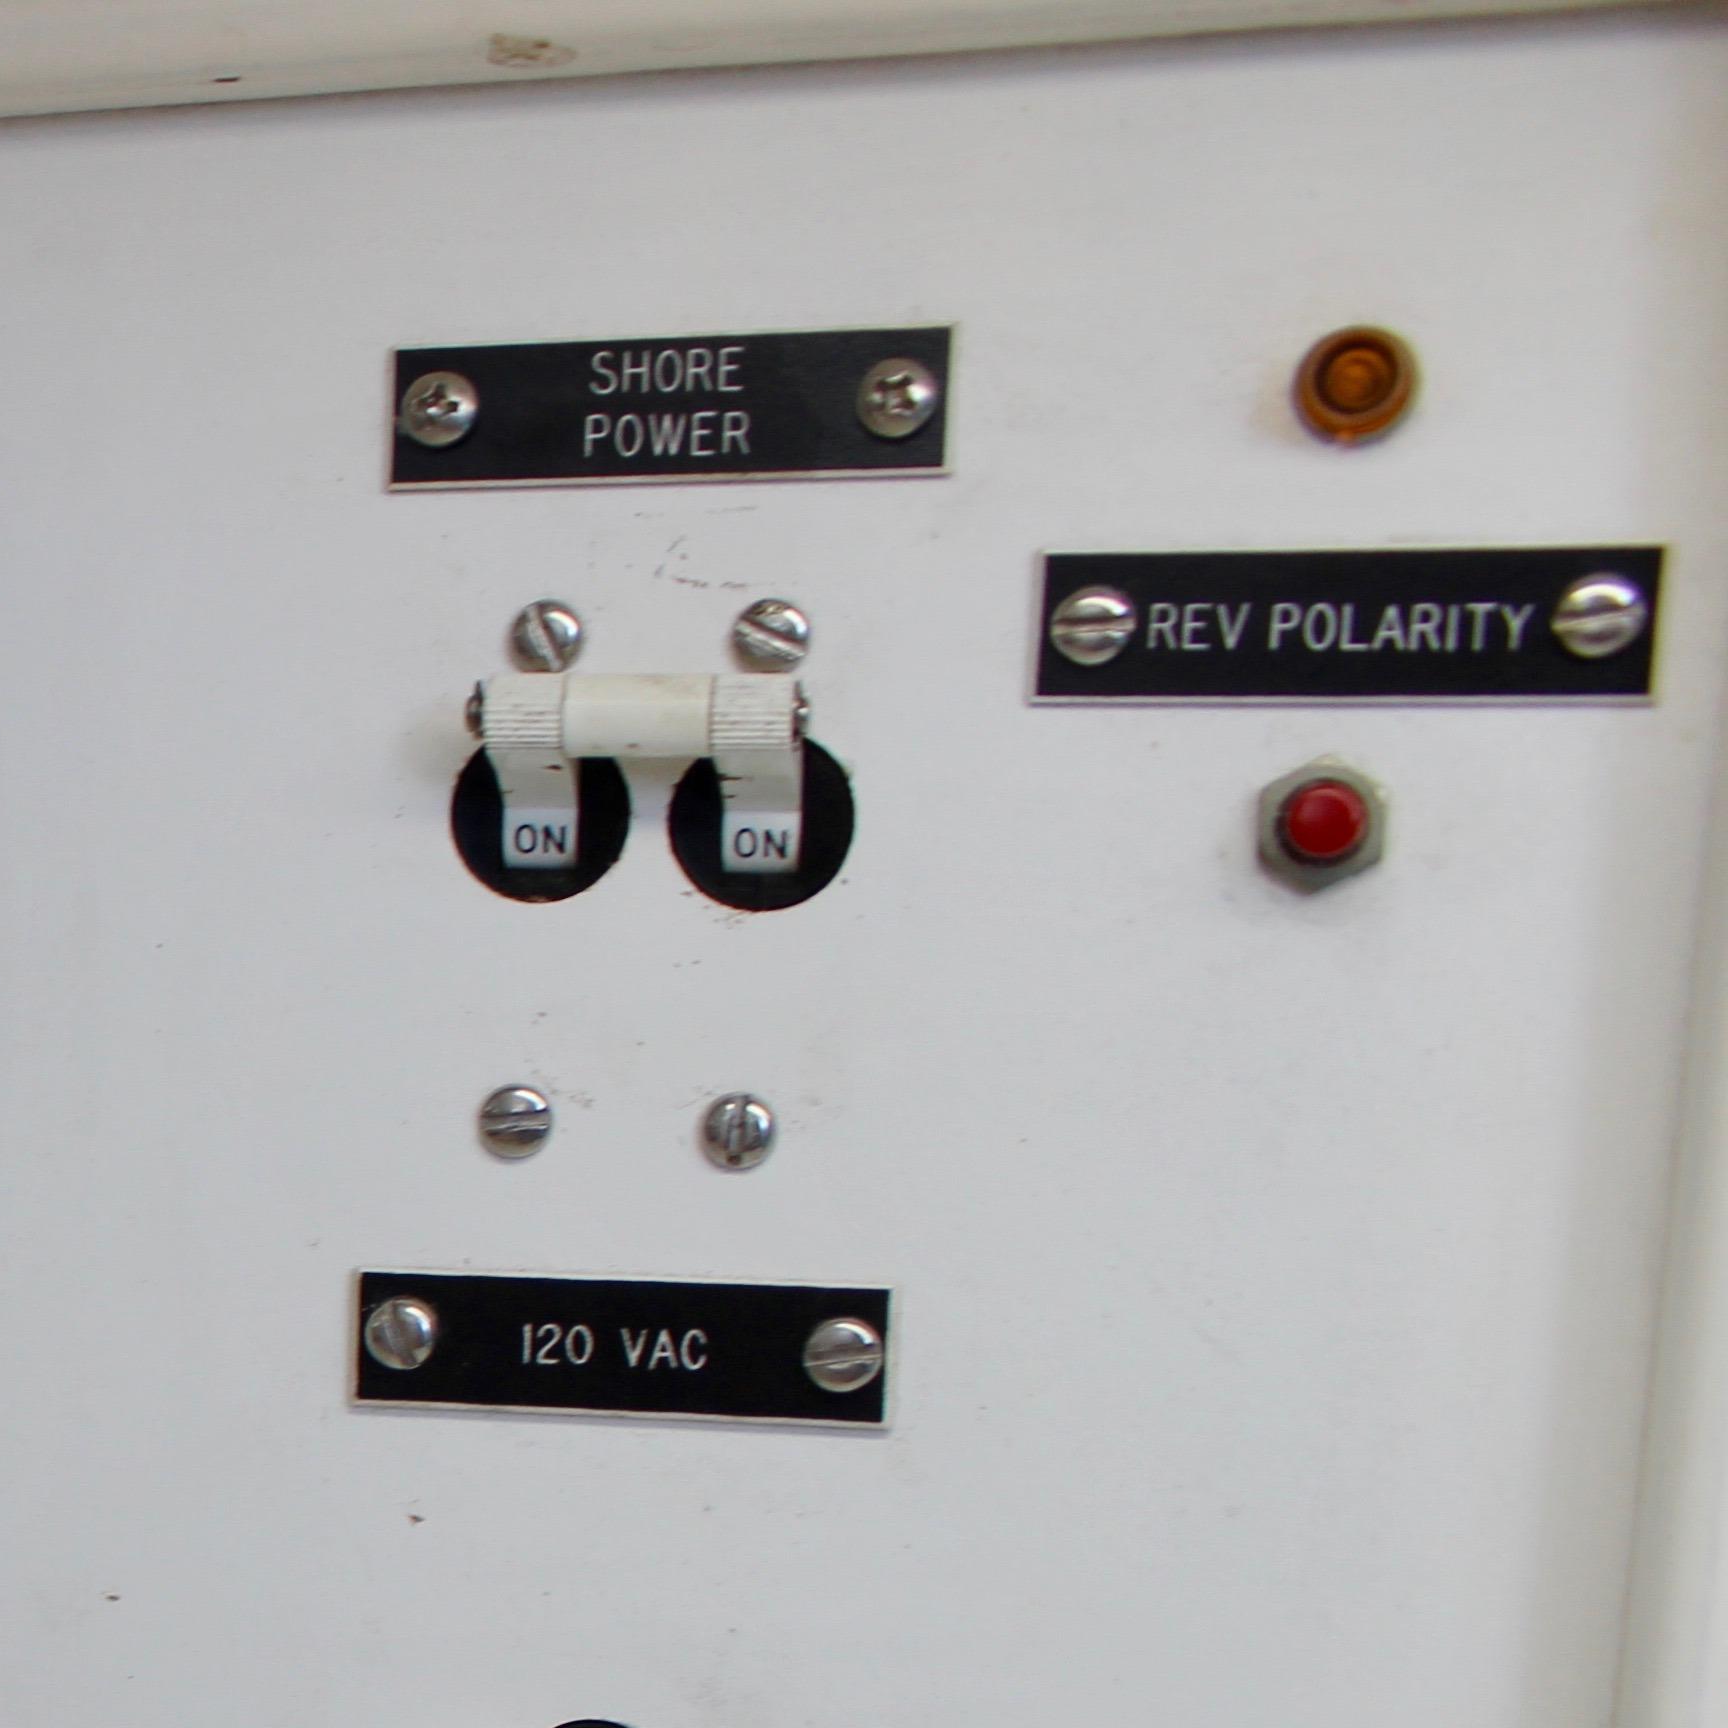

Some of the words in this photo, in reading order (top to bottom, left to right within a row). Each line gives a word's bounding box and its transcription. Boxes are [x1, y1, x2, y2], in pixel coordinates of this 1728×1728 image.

[591, 348, 745, 396] SHORE
[583, 411, 752, 459] POWER
[1147, 602, 1250, 652] REV
[1266, 602, 1538, 653] POLARITY
[513, 823, 567, 855] ON
[733, 827, 789, 860] ON
[519, 1323, 595, 1367] 120
[621, 1327, 709, 1372] VAC
